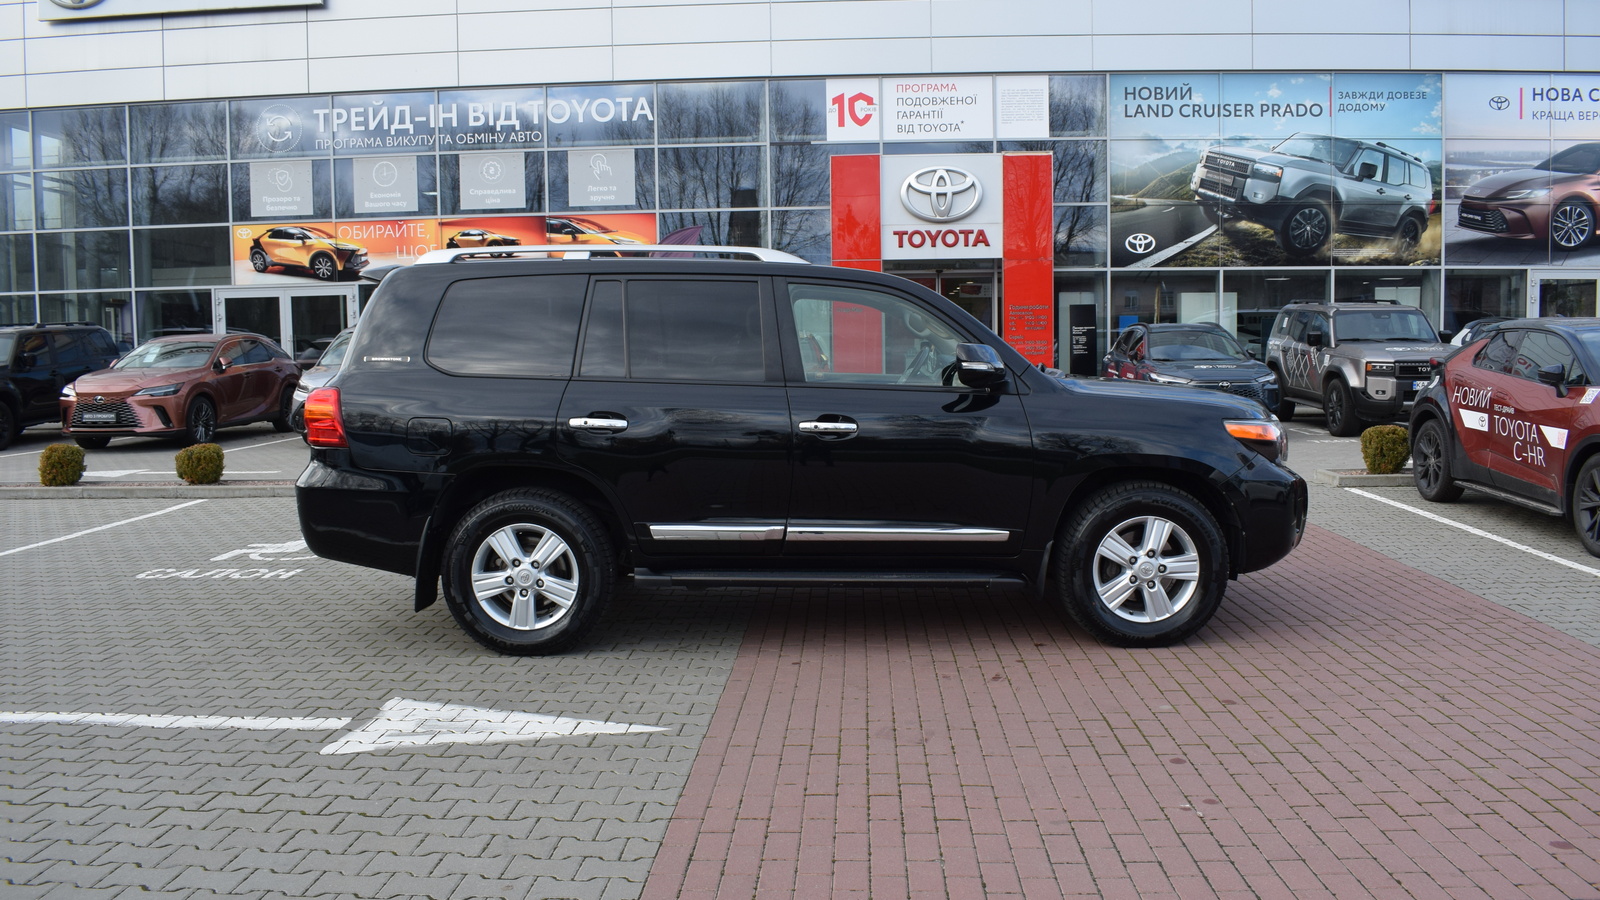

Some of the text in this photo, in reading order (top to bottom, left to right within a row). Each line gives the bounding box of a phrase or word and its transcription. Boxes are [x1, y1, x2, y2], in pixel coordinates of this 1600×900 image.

[896, 83, 957, 93] ПРОГРАМА
[1124, 83, 1192, 101] НОВИЙ
[896, 94, 978, 107] ПОДОВЖЕНОЇ
[1338, 91, 1427, 101] ЗАВЖДИ ДОВЕЗЕ
[1532, 87, 1583, 102] НОВА
[896, 108, 944, 119] ГАРАНТІЇ
[1124, 103, 1323, 118] LAND CRUISER PRADO
[1338, 103, 1386, 113] ДОДОМУ
[313, 97, 654, 135] ТРЕЙД-ІН ВІД TOYOTA
[1532, 110, 1600, 122] КРАЩА ВЕР
[897, 124, 915, 134] ВІД
[315, 131, 542, 150] ПРОГРАМА ВИКУПУ ТА ОБМІНУ АВТО
[1216, 158, 1235, 167] TOYOTA
[469, 188, 517, 196] Справедлива
[590, 194, 615, 202] зручно
[338, 221, 430, 240] ОБИРАЙТЕ,
[893, 229, 990, 248] TOYOTA
[1452, 386, 1492, 409] НОВИЙ
[1493, 403, 1515, 415] ТЕСТ-ДРАЙВ
[1493, 415, 1539, 444] TOYOTA
[1513, 441, 1546, 467] C-HR
[135, 568, 304, 579] САЛОН
